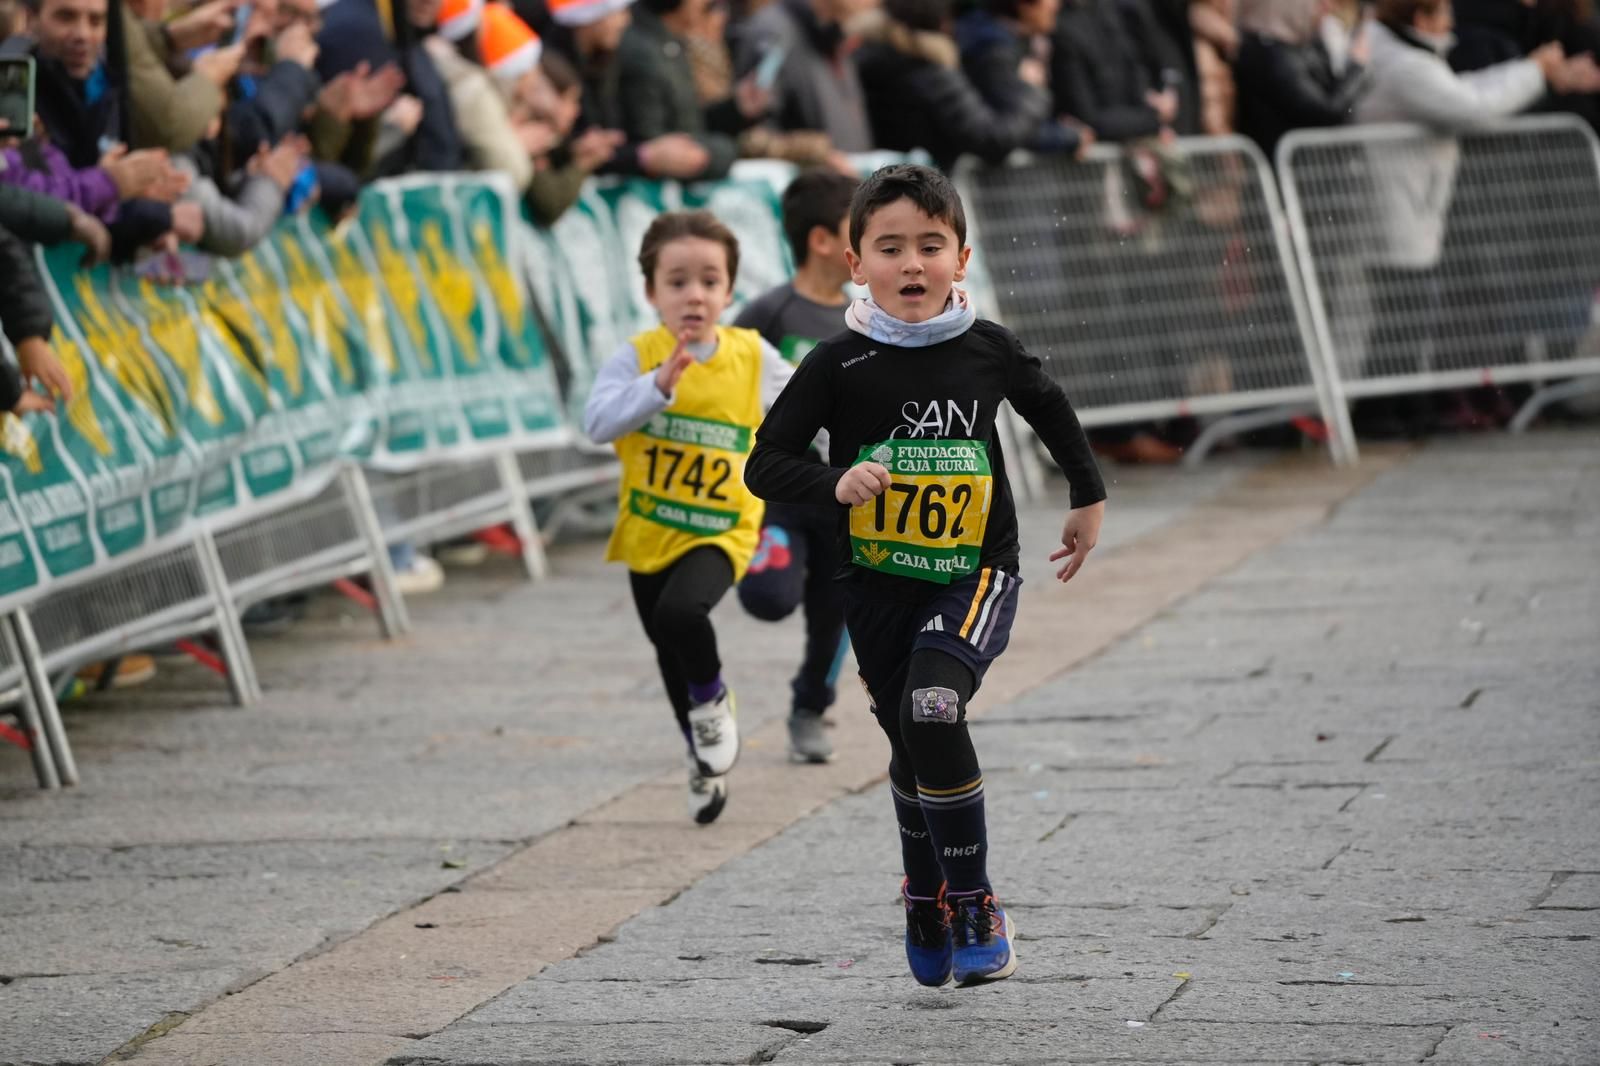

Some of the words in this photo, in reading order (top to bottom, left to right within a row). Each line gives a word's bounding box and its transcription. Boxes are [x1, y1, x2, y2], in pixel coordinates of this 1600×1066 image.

[841, 353, 868, 368] luanvi
[902, 399, 978, 438] SAN
[897, 446, 977, 459] FUNDACION
[644, 445, 731, 502] 1742
[897, 460, 931, 472] CAJA
[935, 460, 978, 472] RURAL
[875, 482, 972, 540] 1762
[892, 552, 930, 570] CAJA
[934, 555, 970, 572] RUAL
[943, 843, 980, 857] RMCF
